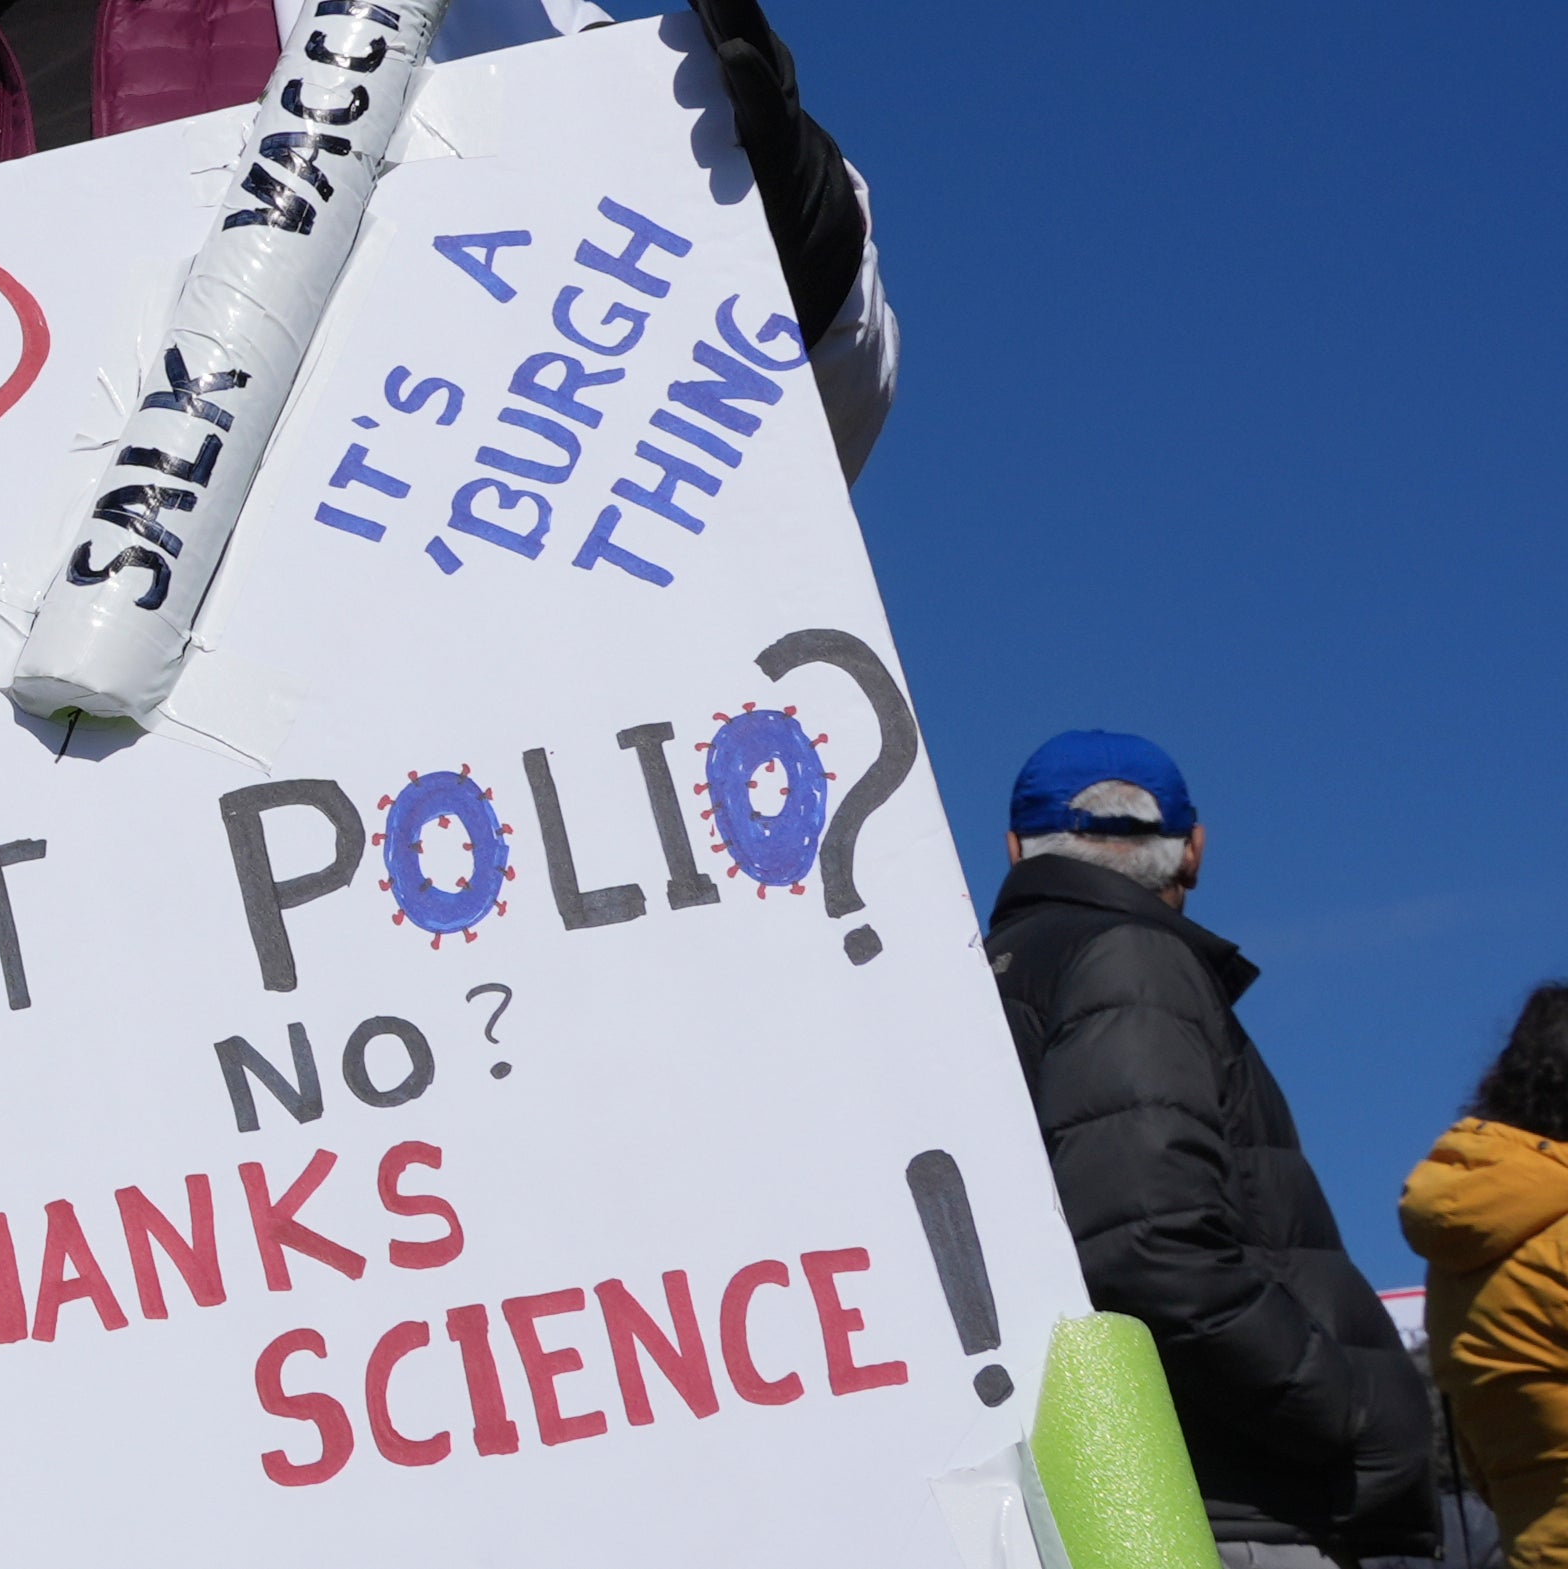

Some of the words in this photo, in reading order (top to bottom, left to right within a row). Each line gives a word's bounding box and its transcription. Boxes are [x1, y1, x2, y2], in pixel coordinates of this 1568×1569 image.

[66, 344, 252, 612] SALK
[314, 364, 464, 543] IT'S
[433, 229, 532, 304] A
[425, 195, 693, 576] 'BURGH
[572, 293, 811, 589] THING
[218, 628, 918, 993] POLIO?
[213, 982, 514, 1133] NO?
